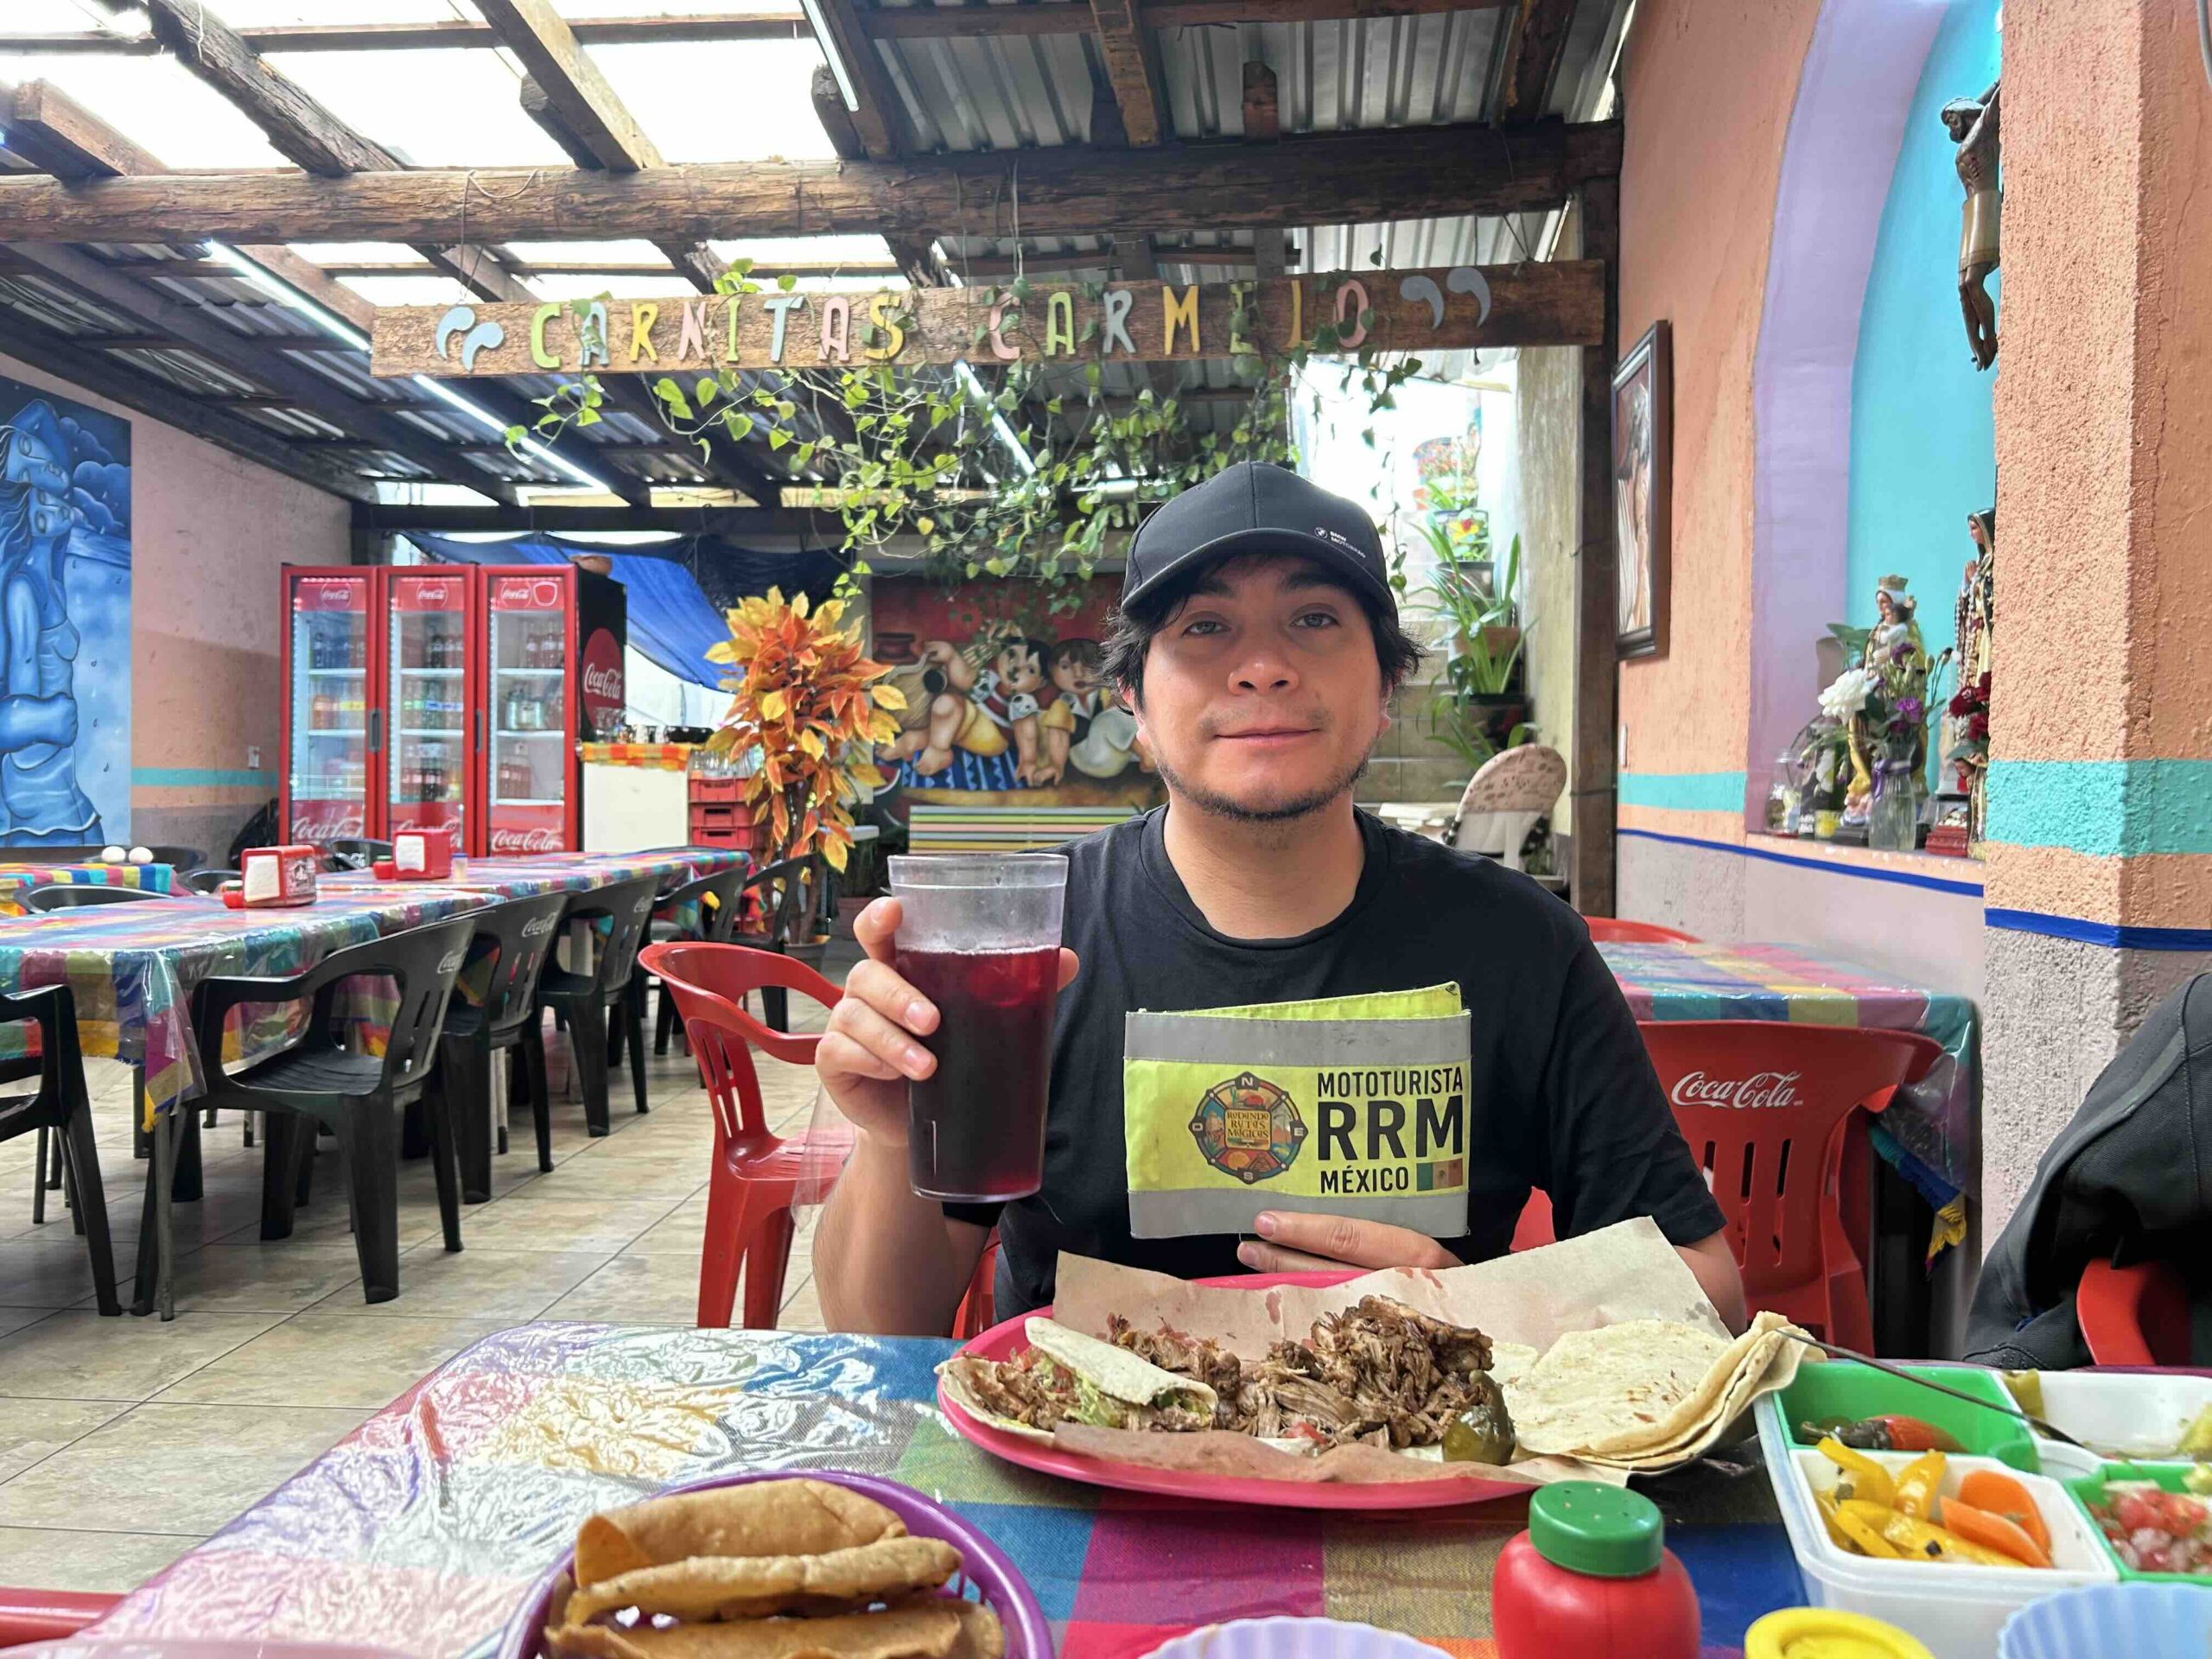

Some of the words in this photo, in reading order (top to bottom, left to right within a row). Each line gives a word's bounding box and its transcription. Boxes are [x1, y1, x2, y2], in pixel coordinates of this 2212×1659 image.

[1318, 1066, 1464, 1097] MOTOTURISTA
[1671, 1071, 1802, 1109] Coca-Cola
[1318, 1094, 1464, 1161] RRM
[1320, 1165, 1409, 1194] MÉXICO
